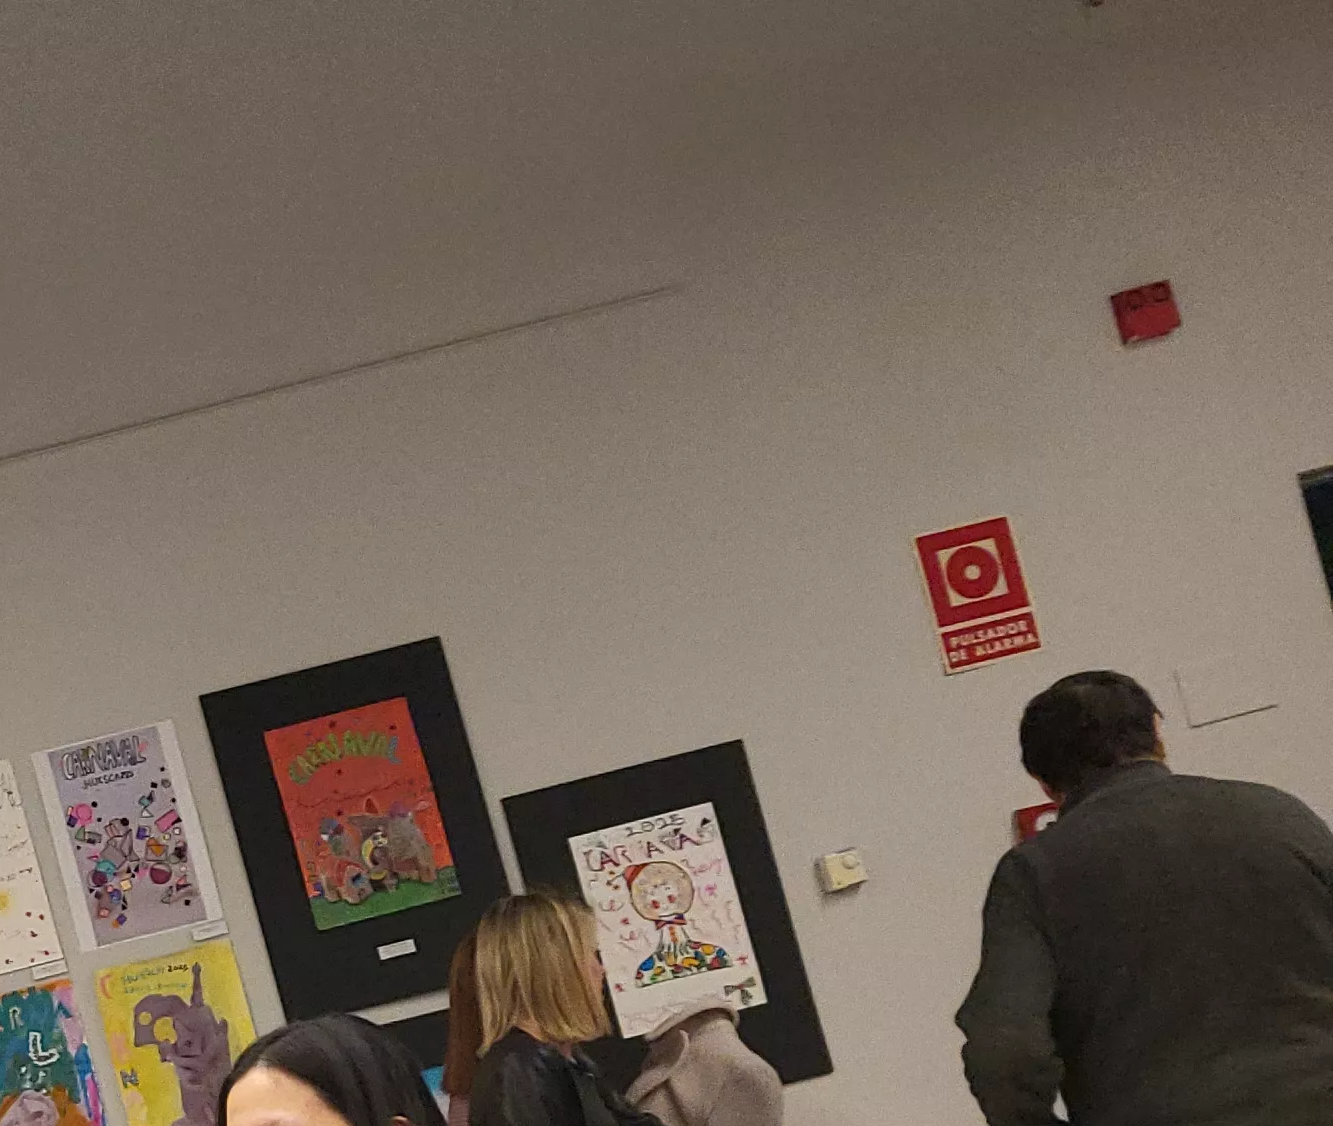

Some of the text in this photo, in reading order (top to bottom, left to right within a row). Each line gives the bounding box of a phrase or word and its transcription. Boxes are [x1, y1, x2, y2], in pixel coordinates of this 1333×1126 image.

[950, 621, 1028, 649] PULSADOR
[950, 633, 1038, 662] DE ALARMA
